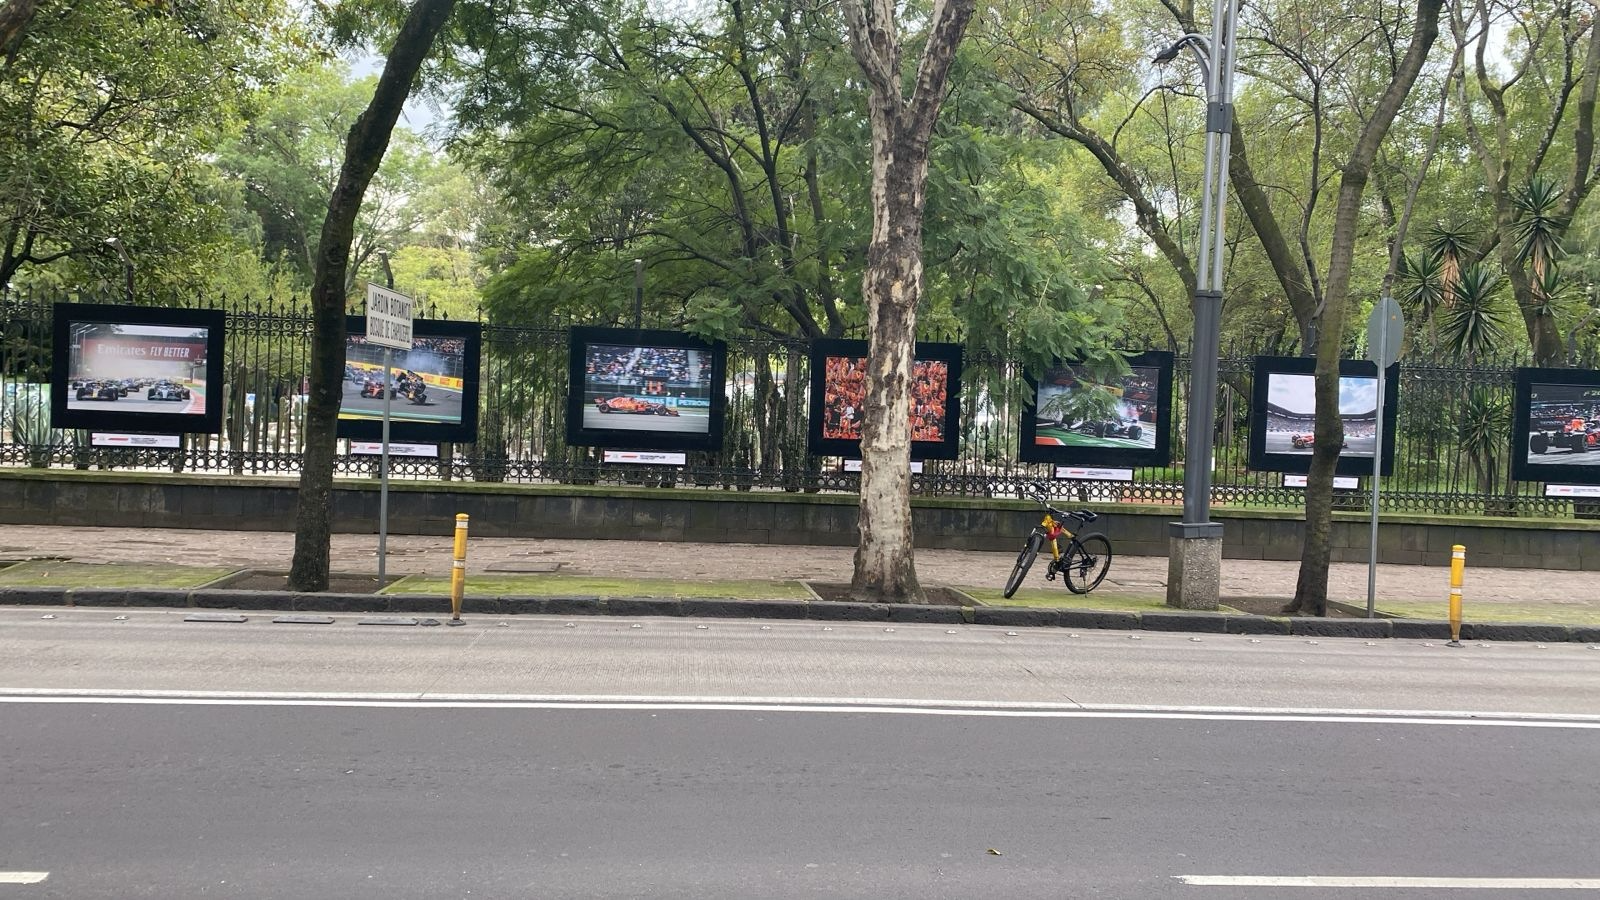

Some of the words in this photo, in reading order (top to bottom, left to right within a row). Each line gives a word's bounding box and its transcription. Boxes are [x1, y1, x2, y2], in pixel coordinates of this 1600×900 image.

[371, 291, 388, 315] JARDIN
[370, 316, 384, 338] BOSQUE
[385, 320, 390, 339] DE
[97, 343, 146, 356] Emirates
[150, 346, 163, 357] FLY
[163, 347, 190, 358] BETTER
